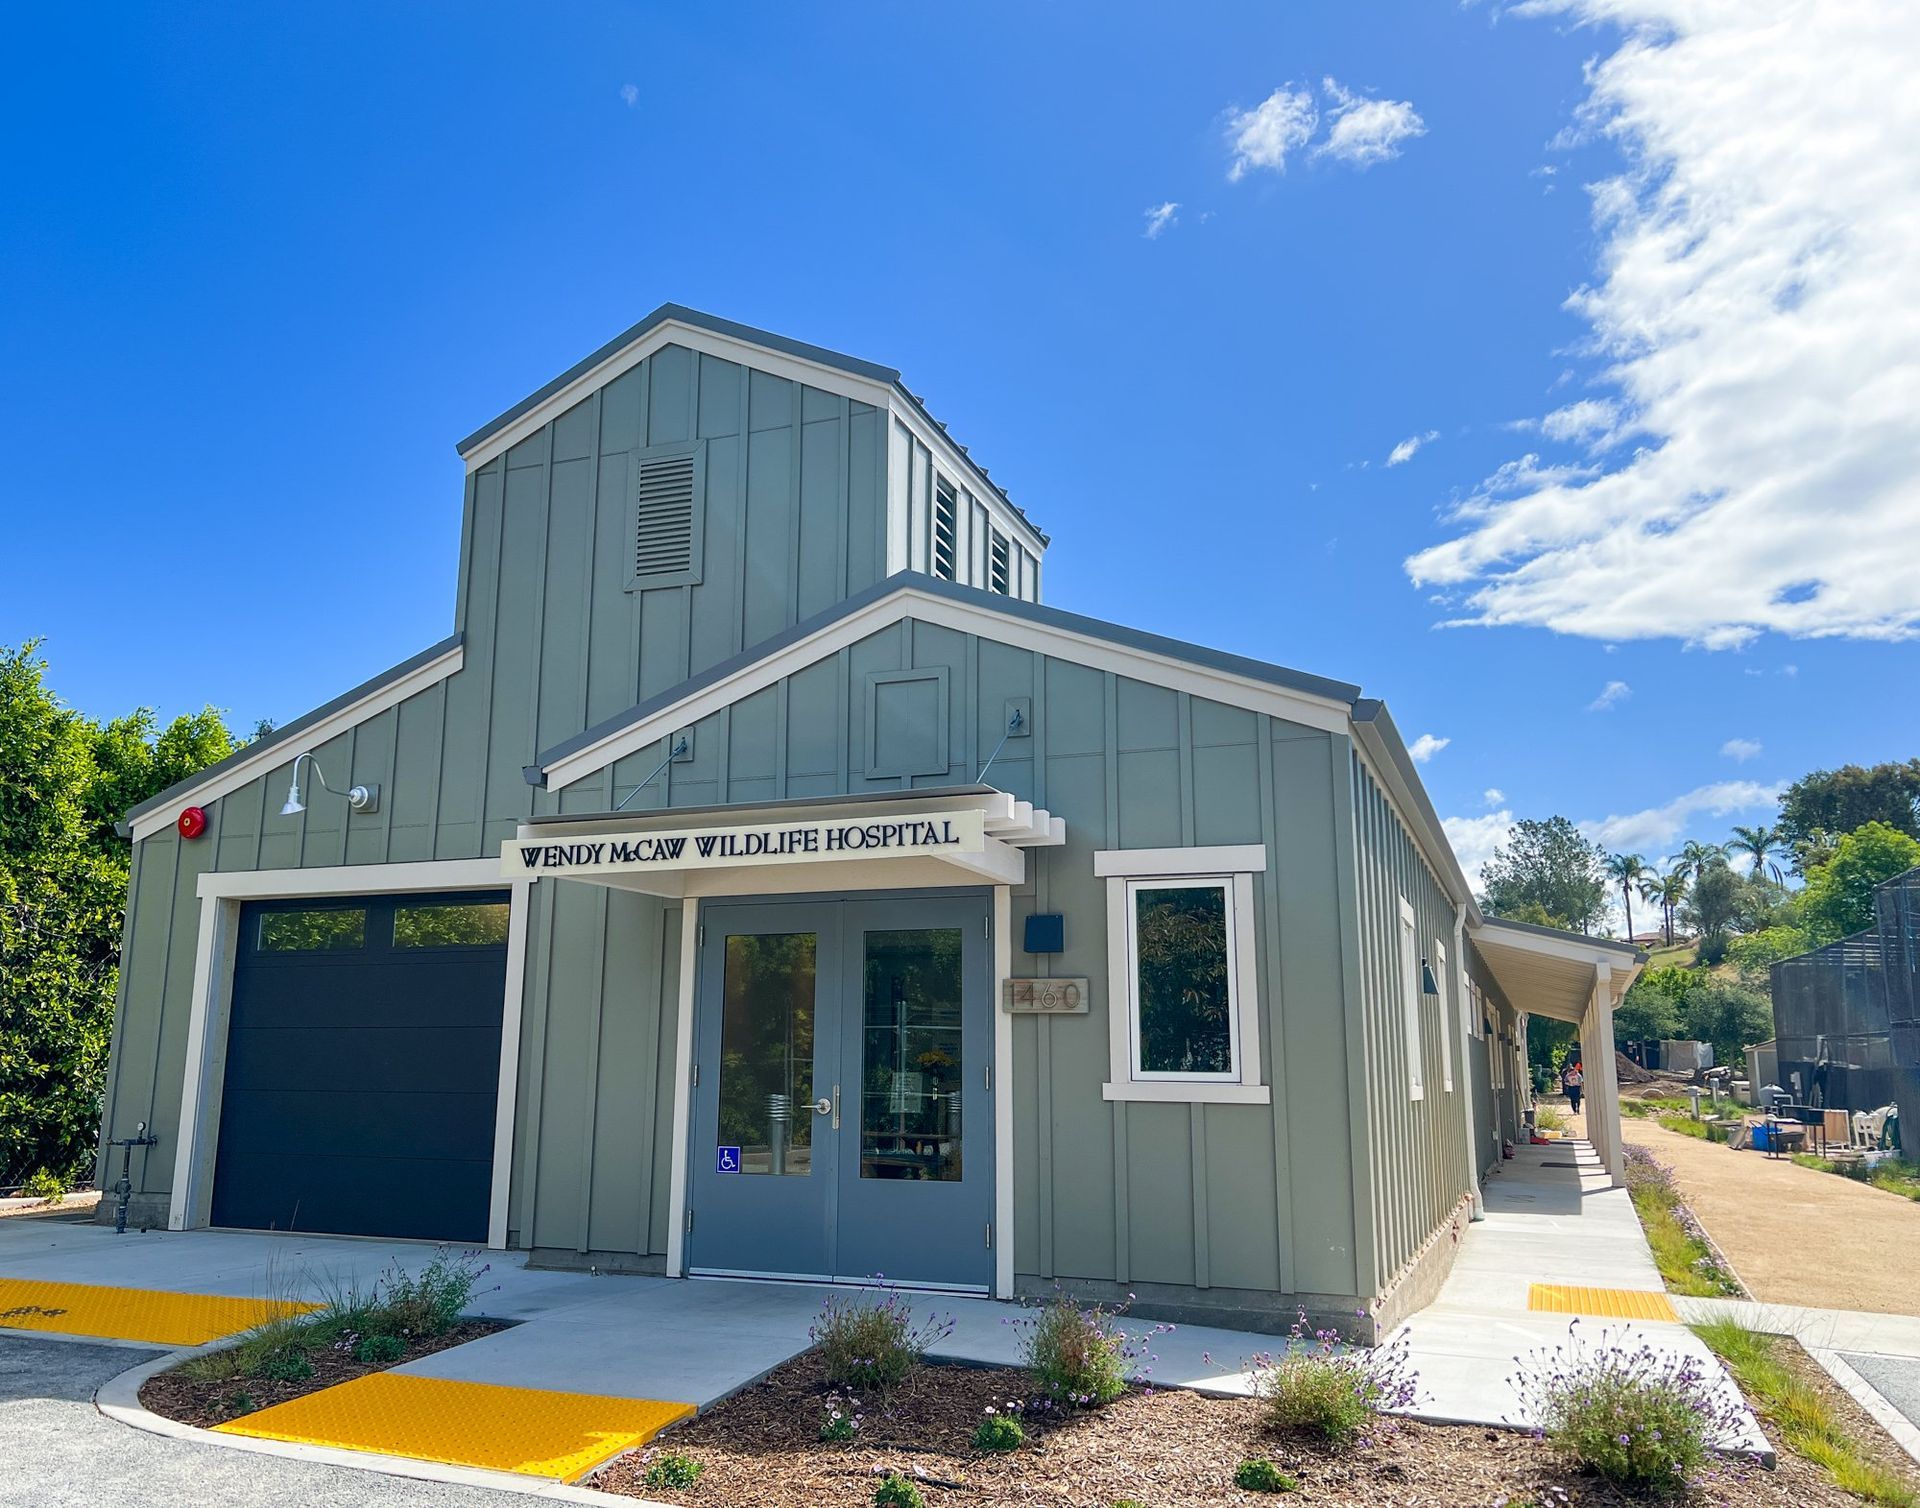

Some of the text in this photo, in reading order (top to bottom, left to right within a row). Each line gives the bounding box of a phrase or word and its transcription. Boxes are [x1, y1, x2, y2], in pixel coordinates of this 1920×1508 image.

[520, 820, 960, 868] WENDY McCAW WILDLIFE HOSPITAL
[1009, 982, 1080, 1008] 1460
